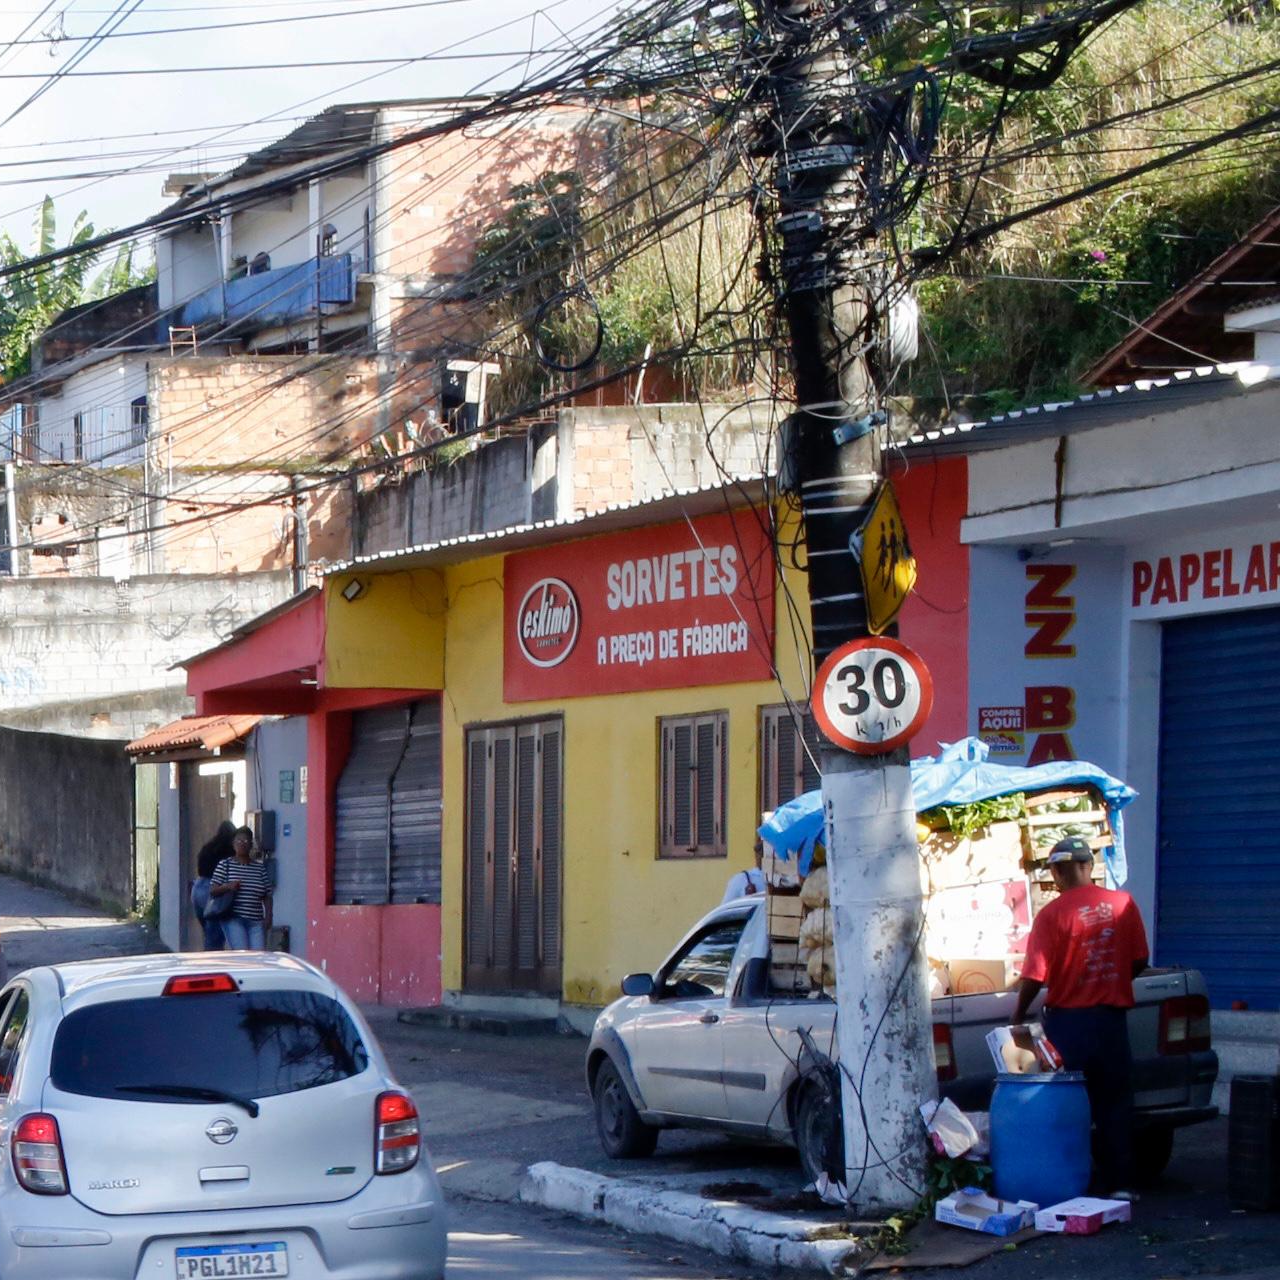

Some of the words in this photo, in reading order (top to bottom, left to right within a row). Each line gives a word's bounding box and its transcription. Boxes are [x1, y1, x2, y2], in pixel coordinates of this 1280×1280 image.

[607, 544, 738, 611] SORVETES
[597, 636, 607, 665] A
[610, 631, 654, 667] PREÇO
[659, 628, 679, 660] DE
[683, 619, 749, 657] FÁBRICA
[837, 657, 906, 716] 30
[981, 709, 1021, 718] COMPRE
[982, 718, 1021, 731] AQUI!
[88, 1178, 141, 1191] MARCH
